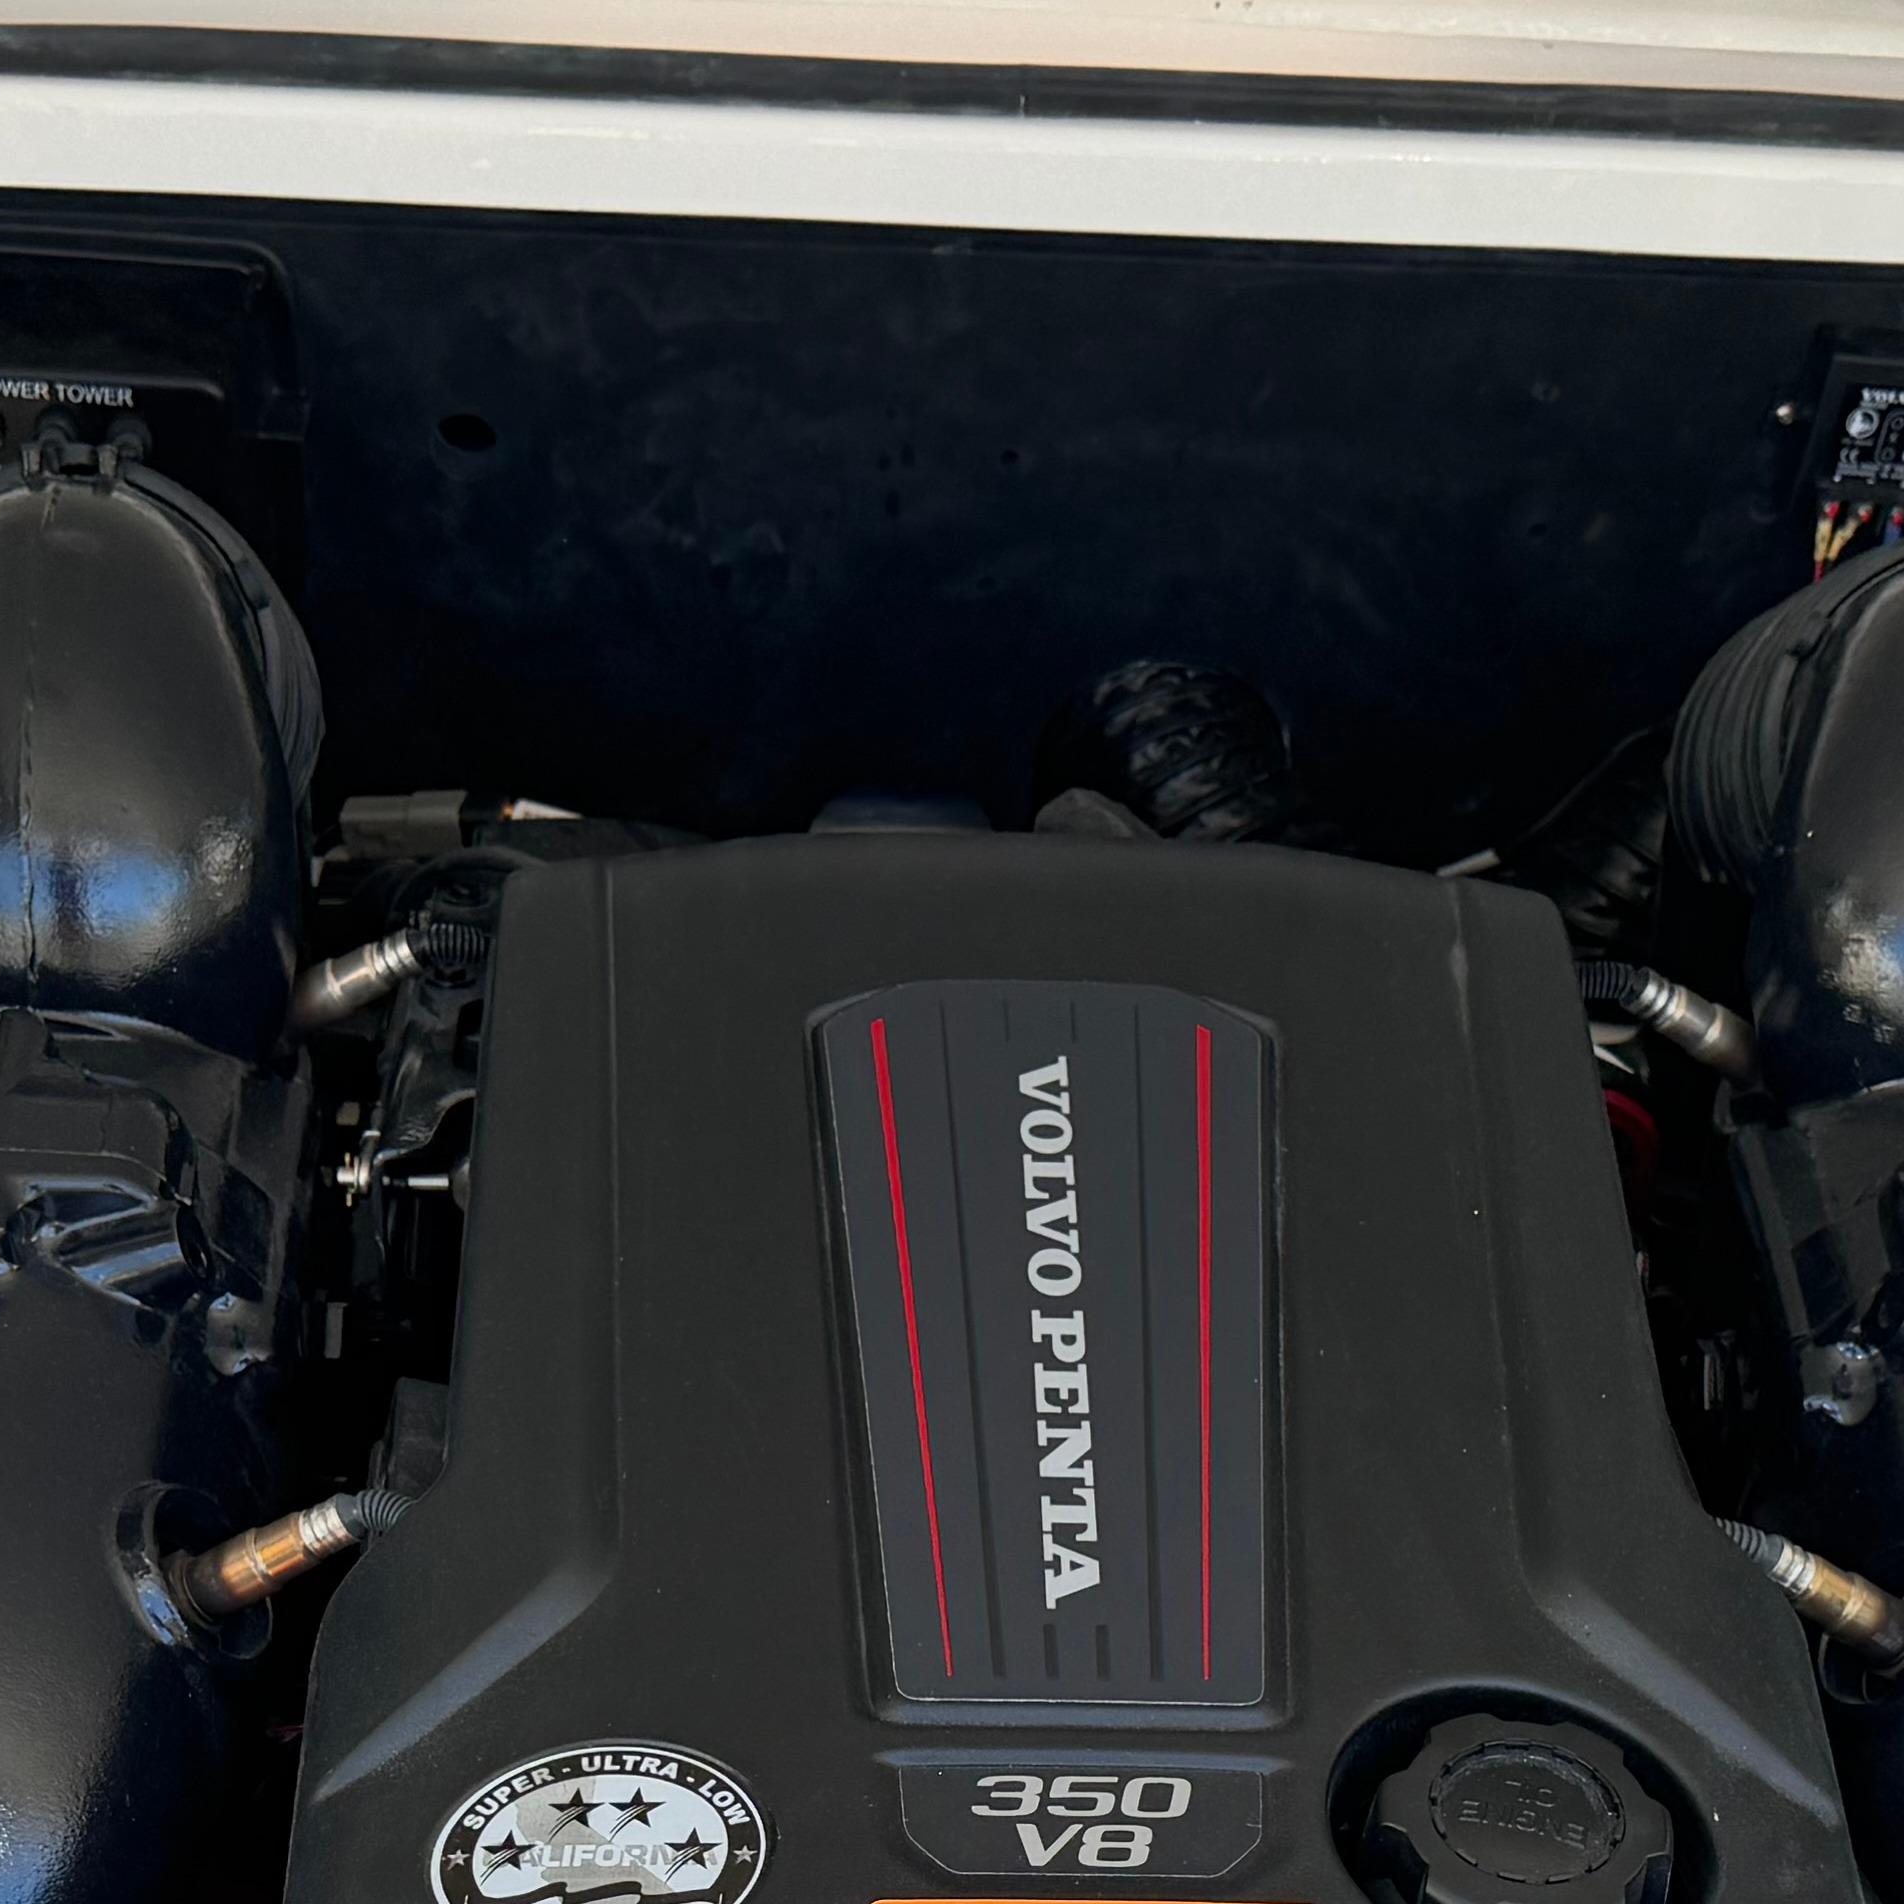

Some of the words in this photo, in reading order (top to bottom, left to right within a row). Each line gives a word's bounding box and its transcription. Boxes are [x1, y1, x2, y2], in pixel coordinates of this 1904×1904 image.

[55, 382, 134, 407] TOWER
[1018, 1055, 1084, 1298] VOLVO
[1030, 1309, 1102, 1611] PENTA
[463, 1767, 555, 1831] SUPER
[581, 1754, 679, 1780] ULTRA
[697, 1779, 752, 1826] LOW
[971, 1775, 1191, 1818] 350
[1015, 1823, 1153, 1868] V8
